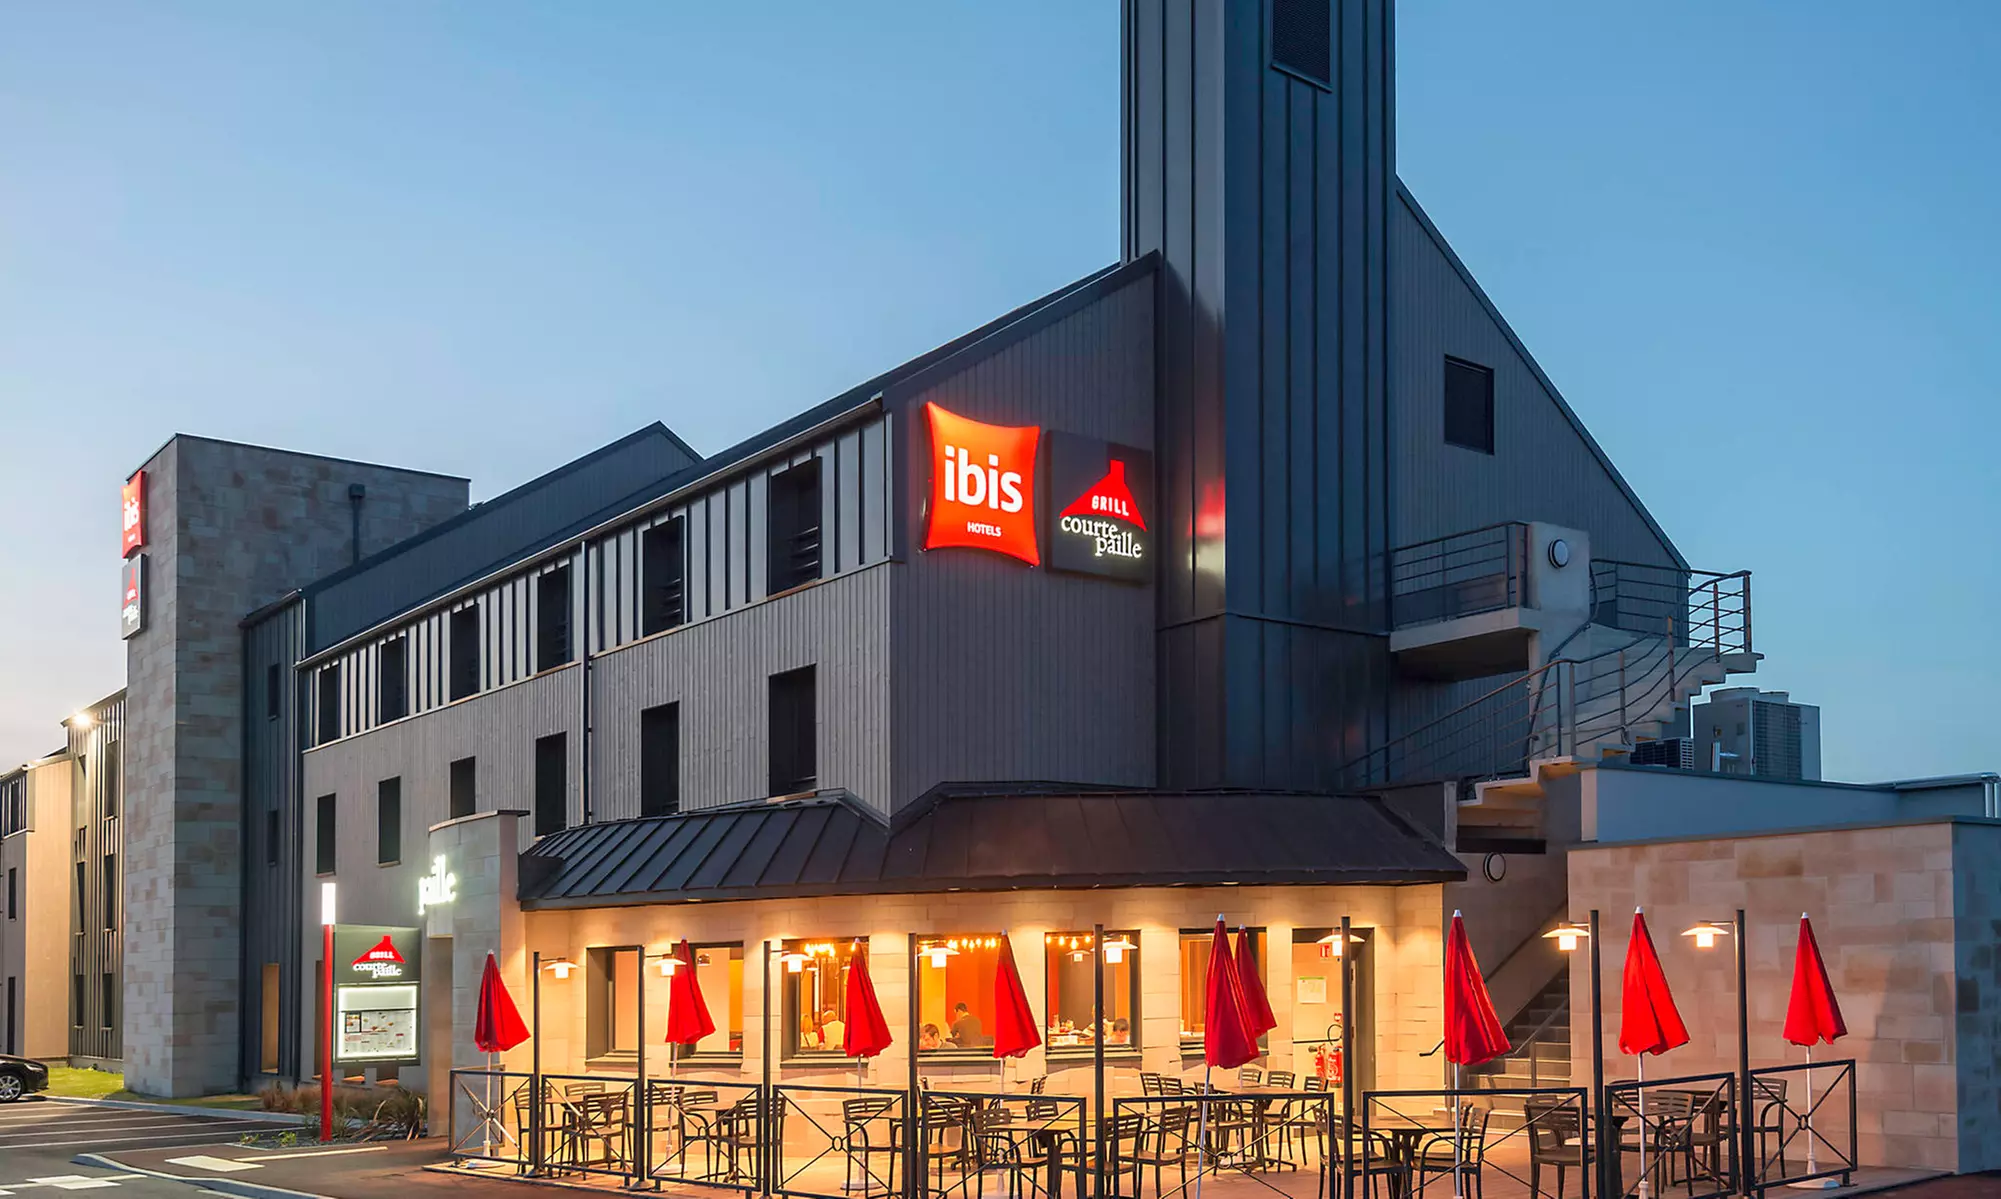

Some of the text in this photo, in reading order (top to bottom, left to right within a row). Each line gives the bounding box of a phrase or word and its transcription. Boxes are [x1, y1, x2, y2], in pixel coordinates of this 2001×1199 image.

[944, 445, 1023, 513] ibis
[1091, 495, 1130, 516] GRILL
[967, 521, 1002, 537] HOTELS
[1061, 516, 1119, 539] courte
[1095, 531, 1142, 559] paille
